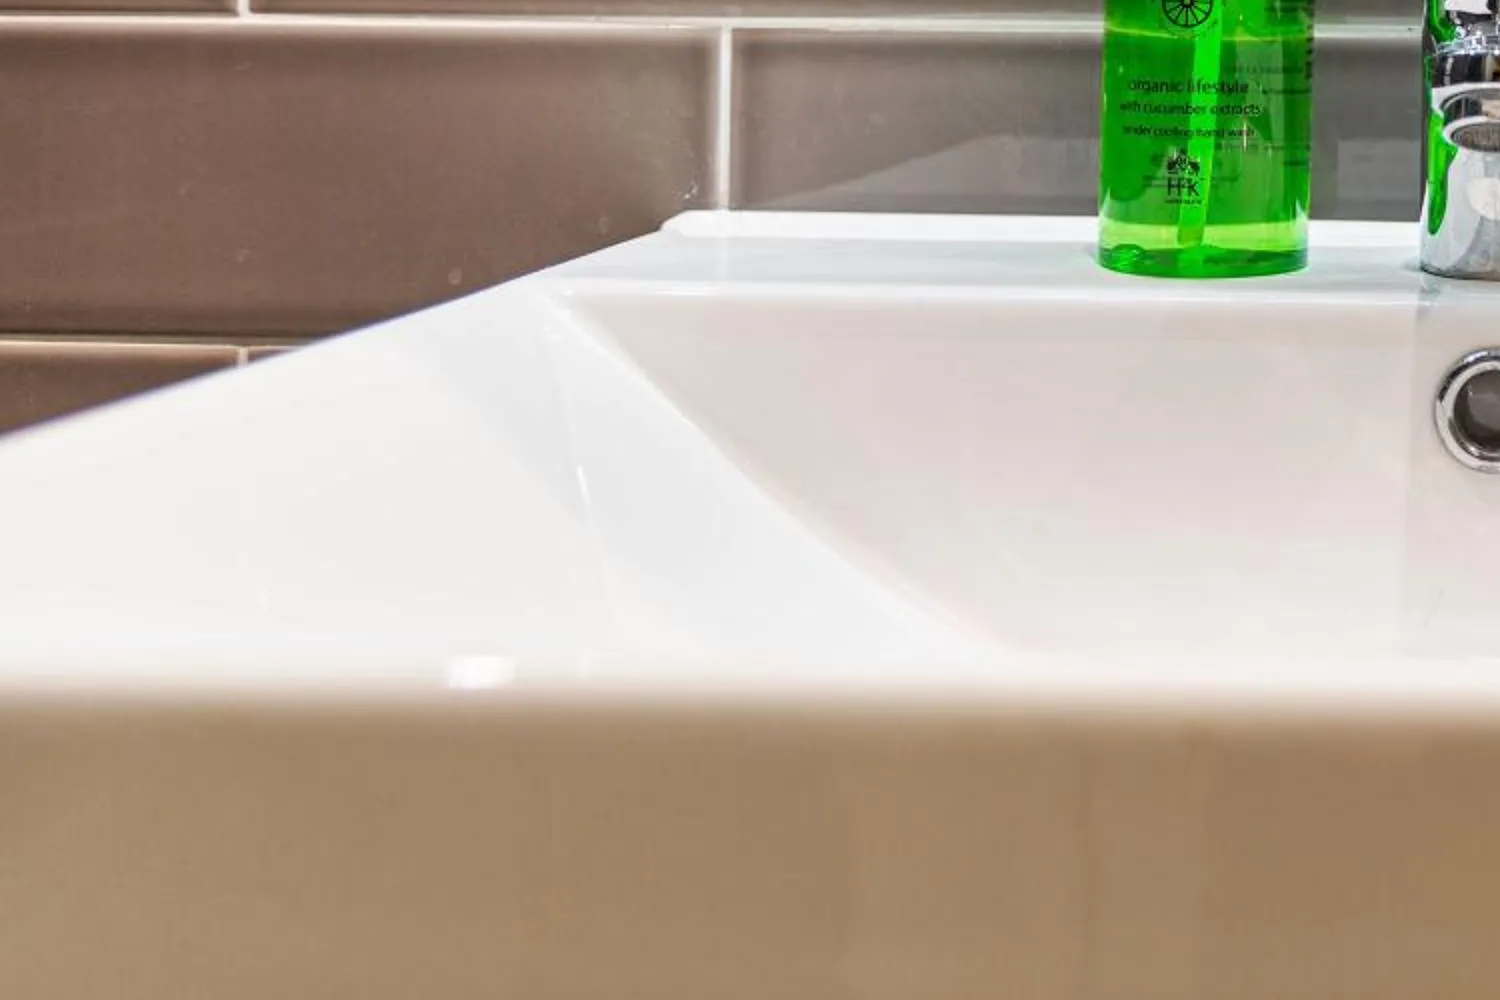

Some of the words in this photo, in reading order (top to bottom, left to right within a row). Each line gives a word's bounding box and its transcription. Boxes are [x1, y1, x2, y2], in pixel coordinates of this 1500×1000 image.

[1128, 79, 1183, 95] organic
[1187, 78, 1249, 94] lifestyle
[1143, 102, 1207, 115] cucumber
